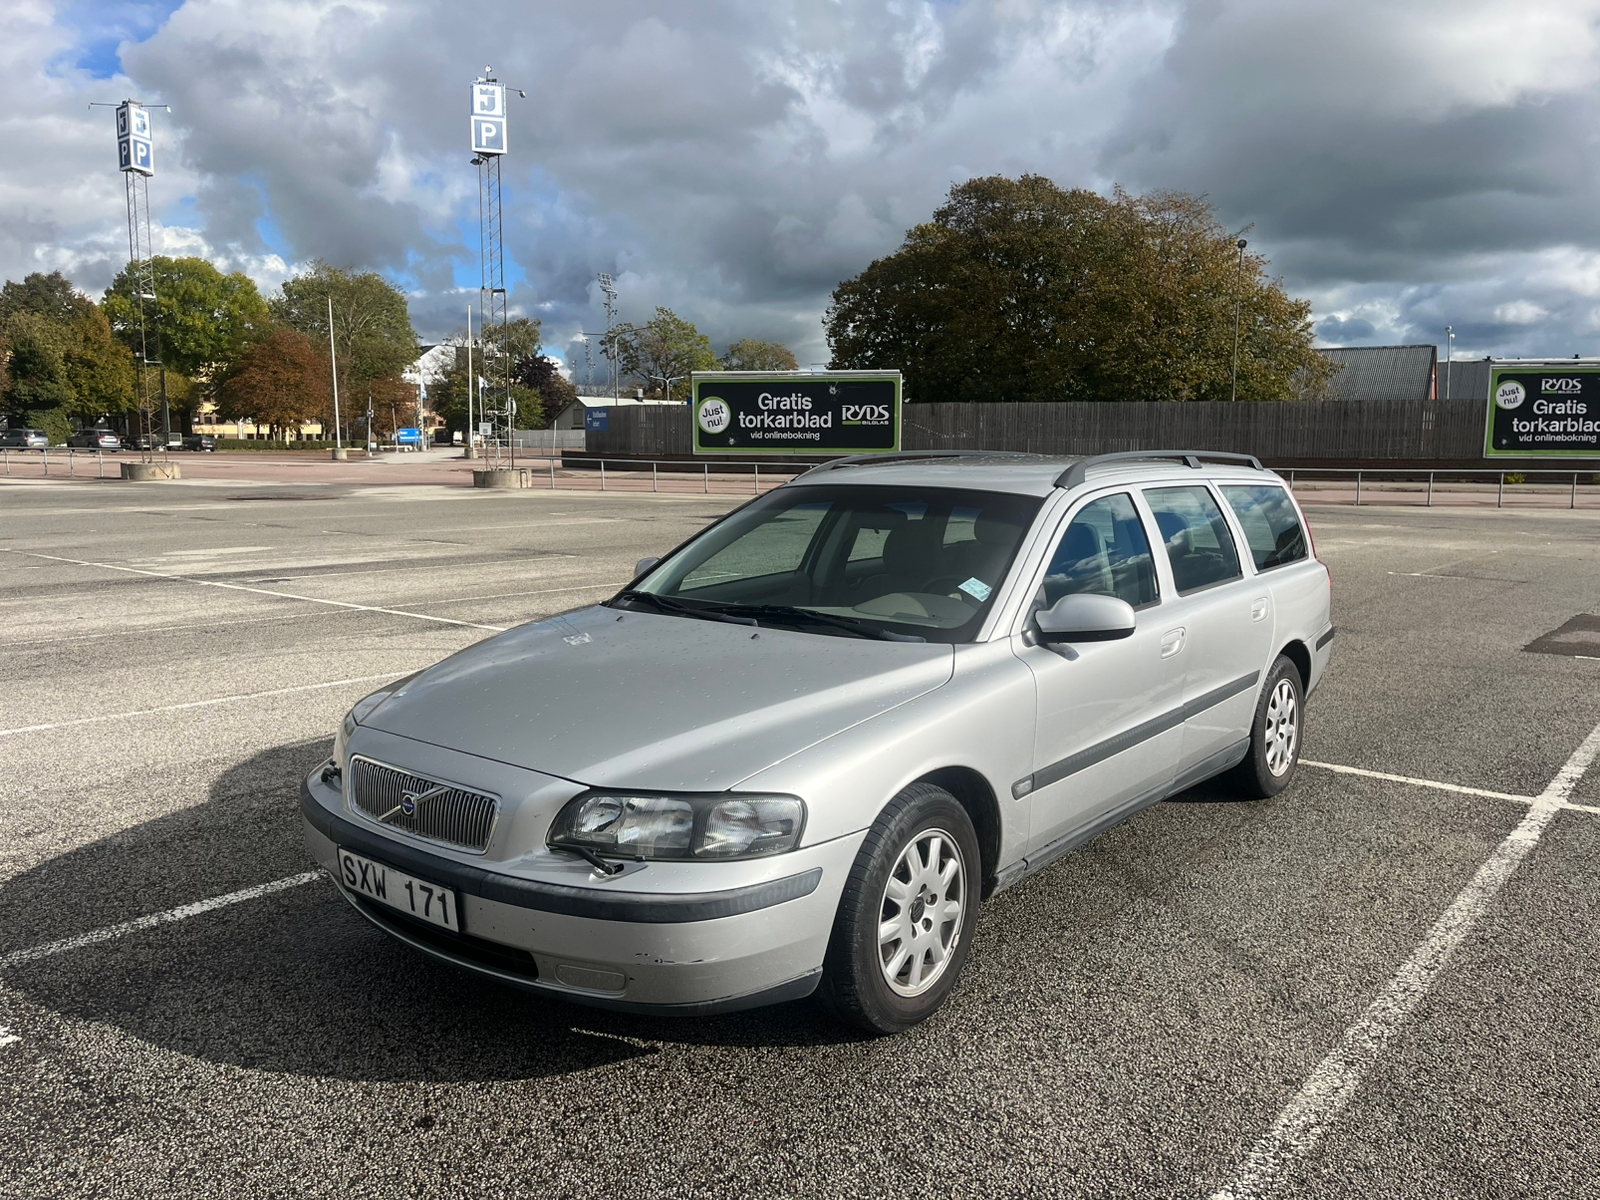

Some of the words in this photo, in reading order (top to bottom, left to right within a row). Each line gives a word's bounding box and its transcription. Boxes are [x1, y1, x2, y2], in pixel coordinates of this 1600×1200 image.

[481, 122, 497, 147] P
[121, 142, 128, 165] P
[136, 142, 147, 165] P
[1541, 378, 1582, 391] RYDS
[1500, 387, 1520, 397] Just
[757, 392, 813, 410] Gratis
[1503, 395, 1518, 405] nu!
[1533, 400, 1587, 414] Gratis
[702, 404, 724, 418] Just
[841, 404, 890, 421] RYDS
[707, 416, 723, 428] nu!
[738, 411, 832, 428] torkarblad
[750, 431, 763, 439] vid
[764, 431, 820, 441] onlinebokning
[1518, 434, 1533, 442] vid
[1534, 433, 1597, 443] onlinebokning
[343, 854, 387, 900] SXW
[404, 880, 449, 925] 171
